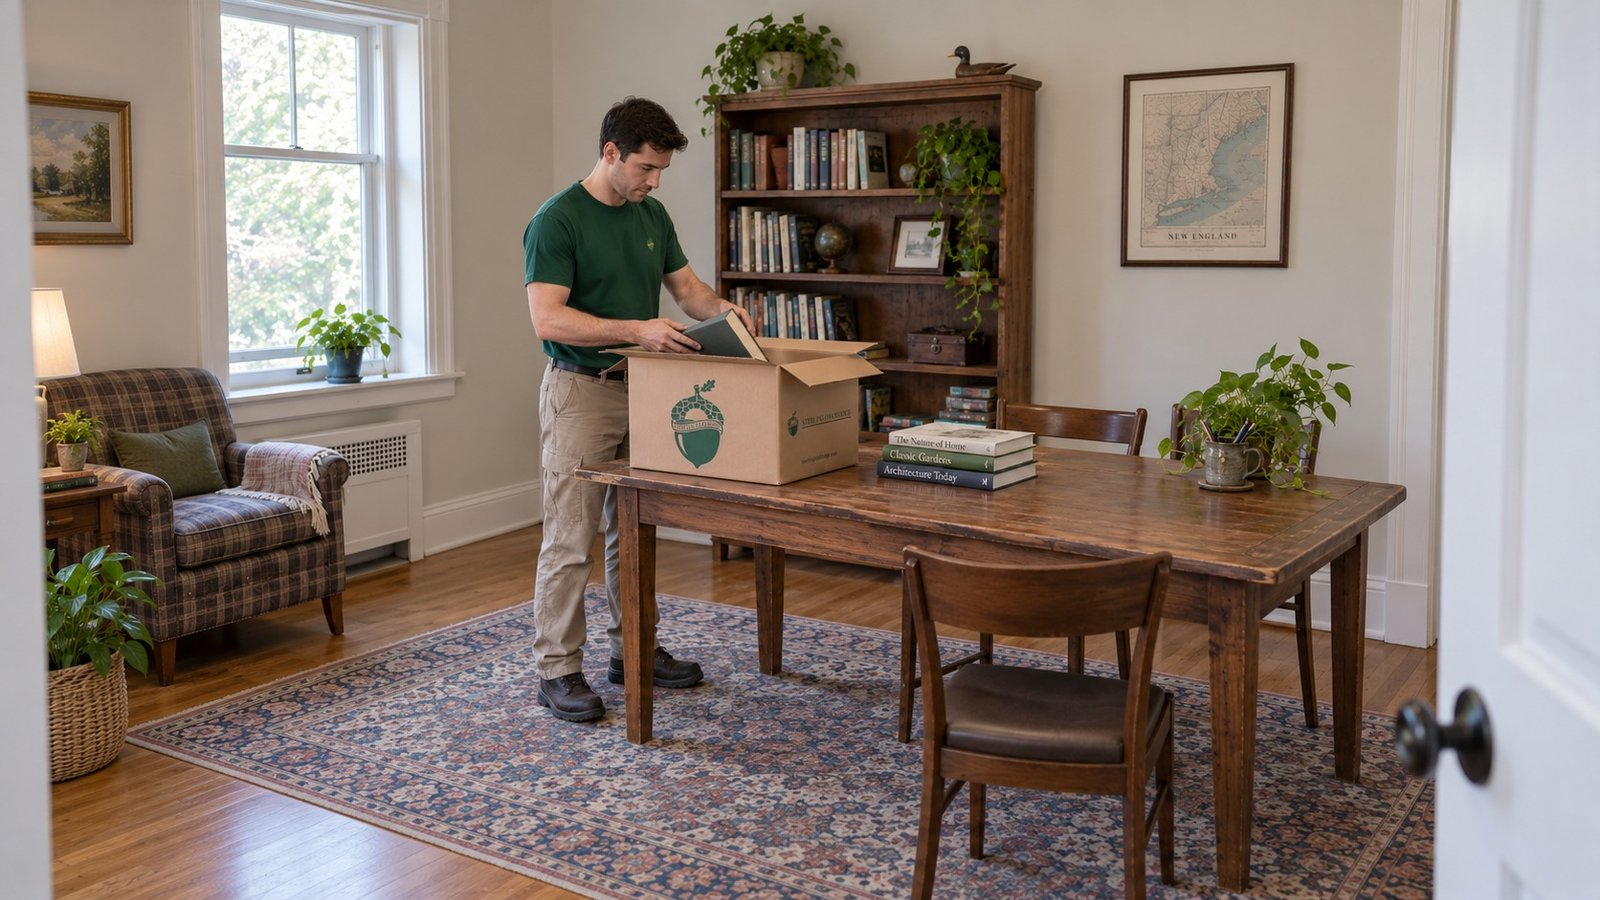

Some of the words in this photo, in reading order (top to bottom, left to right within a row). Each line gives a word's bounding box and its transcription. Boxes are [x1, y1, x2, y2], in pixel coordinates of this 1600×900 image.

[894, 435, 909, 444] The
[911, 437, 935, 447] Nature
[935, 440, 943, 449] of
[944, 441, 967, 451] Home
[890, 449, 916, 461] Classic
[918, 452, 952, 464] Gardens
[884, 466, 932, 479] Architecture
[933, 470, 958, 485] Today
